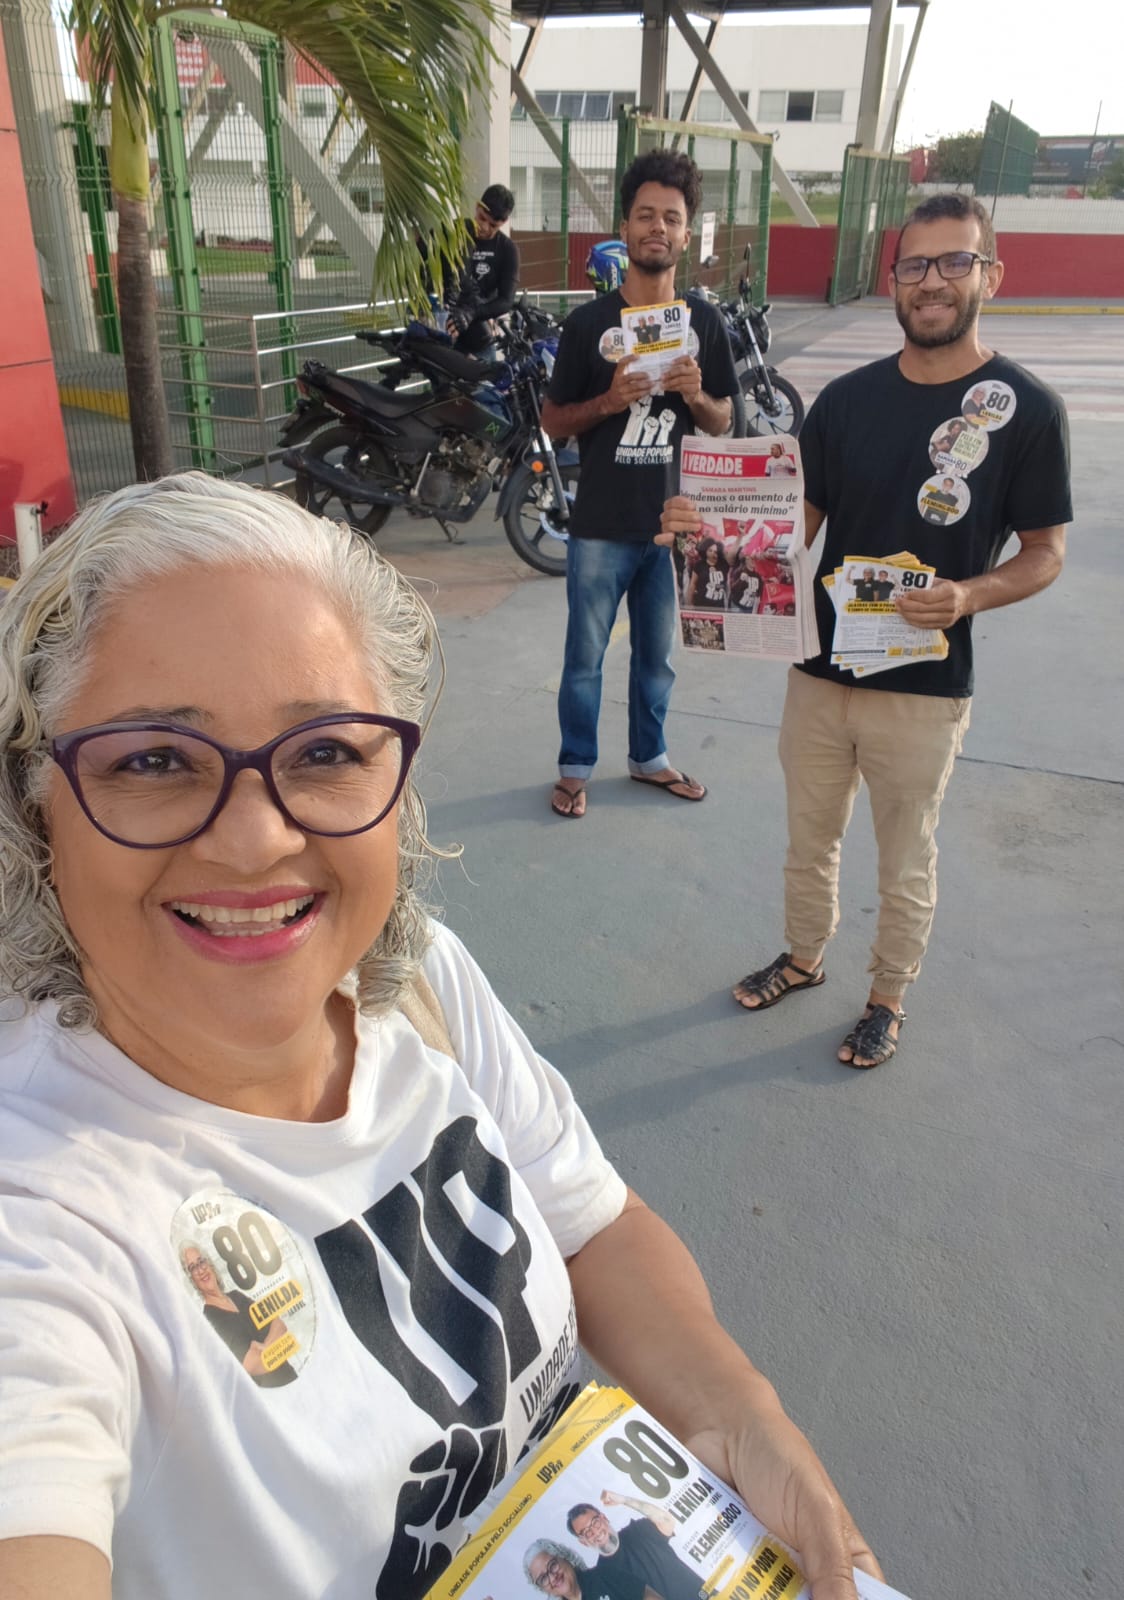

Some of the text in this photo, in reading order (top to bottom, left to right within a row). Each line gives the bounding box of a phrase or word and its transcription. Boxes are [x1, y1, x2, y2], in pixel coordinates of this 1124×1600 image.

[664, 307, 680, 323] 80
[986, 391, 1011, 412] 80
[615, 455, 631, 464] PELO
[616, 446, 646, 457] UNIDADE
[688, 453, 743, 475] VERDADE
[954, 461, 967, 471] 80
[729, 494, 736, 502] o
[738, 493, 784, 502] aumento
[785, 492, 798, 503] de
[713, 504, 749, 514] salário
[901, 571, 929, 589] 80
[212, 1211, 282, 1290] 80
[251, 1281, 301, 1323] LENILDA
[520, 1323, 570, 1423] UNIDADE
[603, 1420, 689, 1499] 80
[668, 1477, 715, 1525] LENILDA
[688, 1502, 742, 1564] FLEMING800
[448, 1570, 471, 1597] UNIDADE
[469, 1540, 493, 1572] POPULAR
[502, 1493, 533, 1529] SOCIALISMO
[741, 1570, 761, 1592] NO
[751, 1546, 779, 1579] PODER
